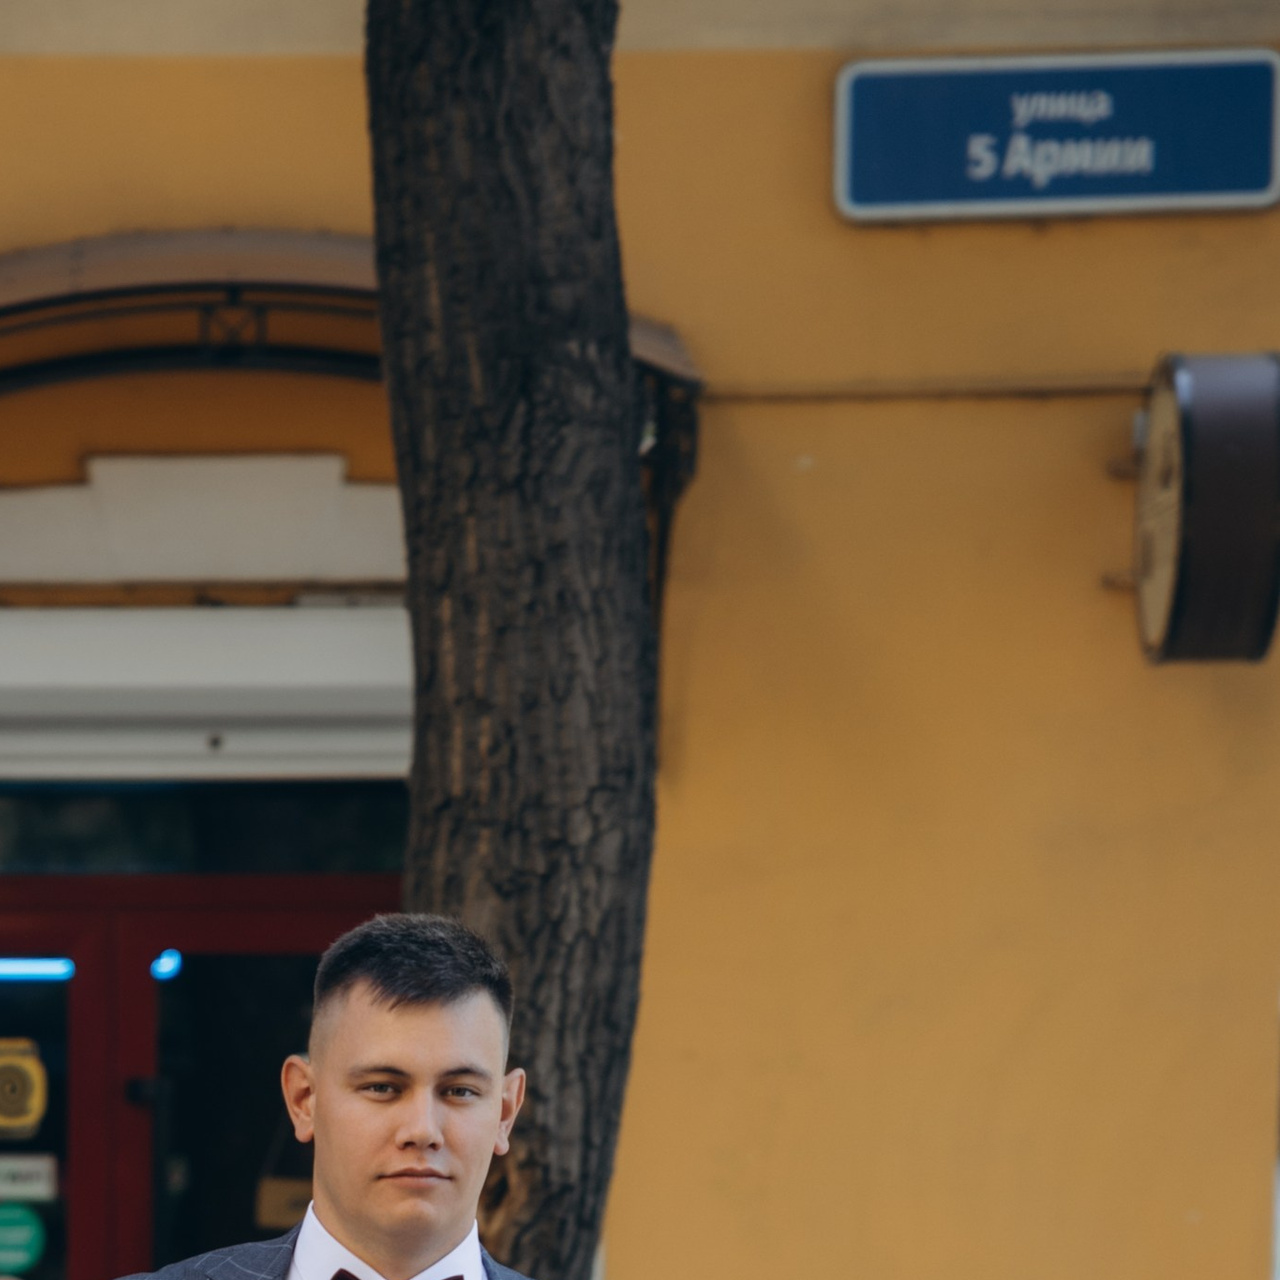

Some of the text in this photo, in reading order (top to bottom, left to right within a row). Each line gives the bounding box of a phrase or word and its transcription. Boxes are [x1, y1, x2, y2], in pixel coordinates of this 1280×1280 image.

[1011, 91, 1113, 128] улица
[967, 131, 1154, 188] 5 Армии
